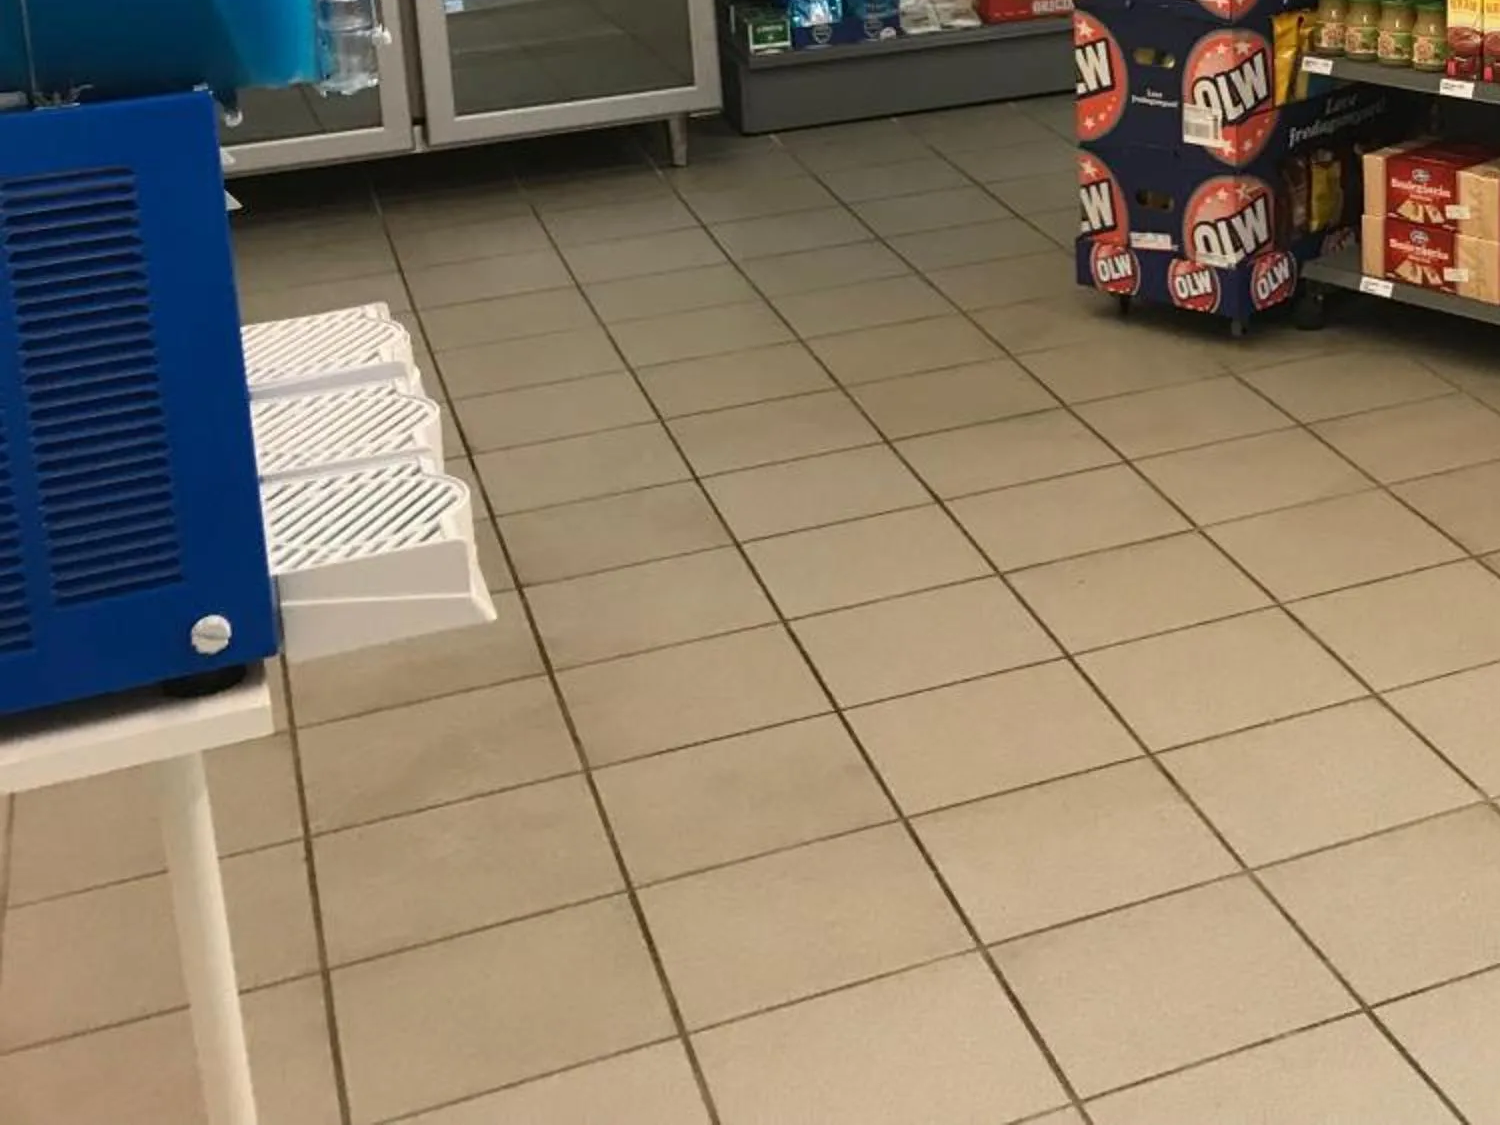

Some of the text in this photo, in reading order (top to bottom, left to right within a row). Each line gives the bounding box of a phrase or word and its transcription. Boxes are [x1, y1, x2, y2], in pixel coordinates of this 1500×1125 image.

[1192, 49, 1271, 122] OLW
[1192, 193, 1271, 263] OLW
[1099, 254, 1133, 283] OLW
[1174, 270, 1213, 300] OLW
[1256, 255, 1291, 300] OLW
